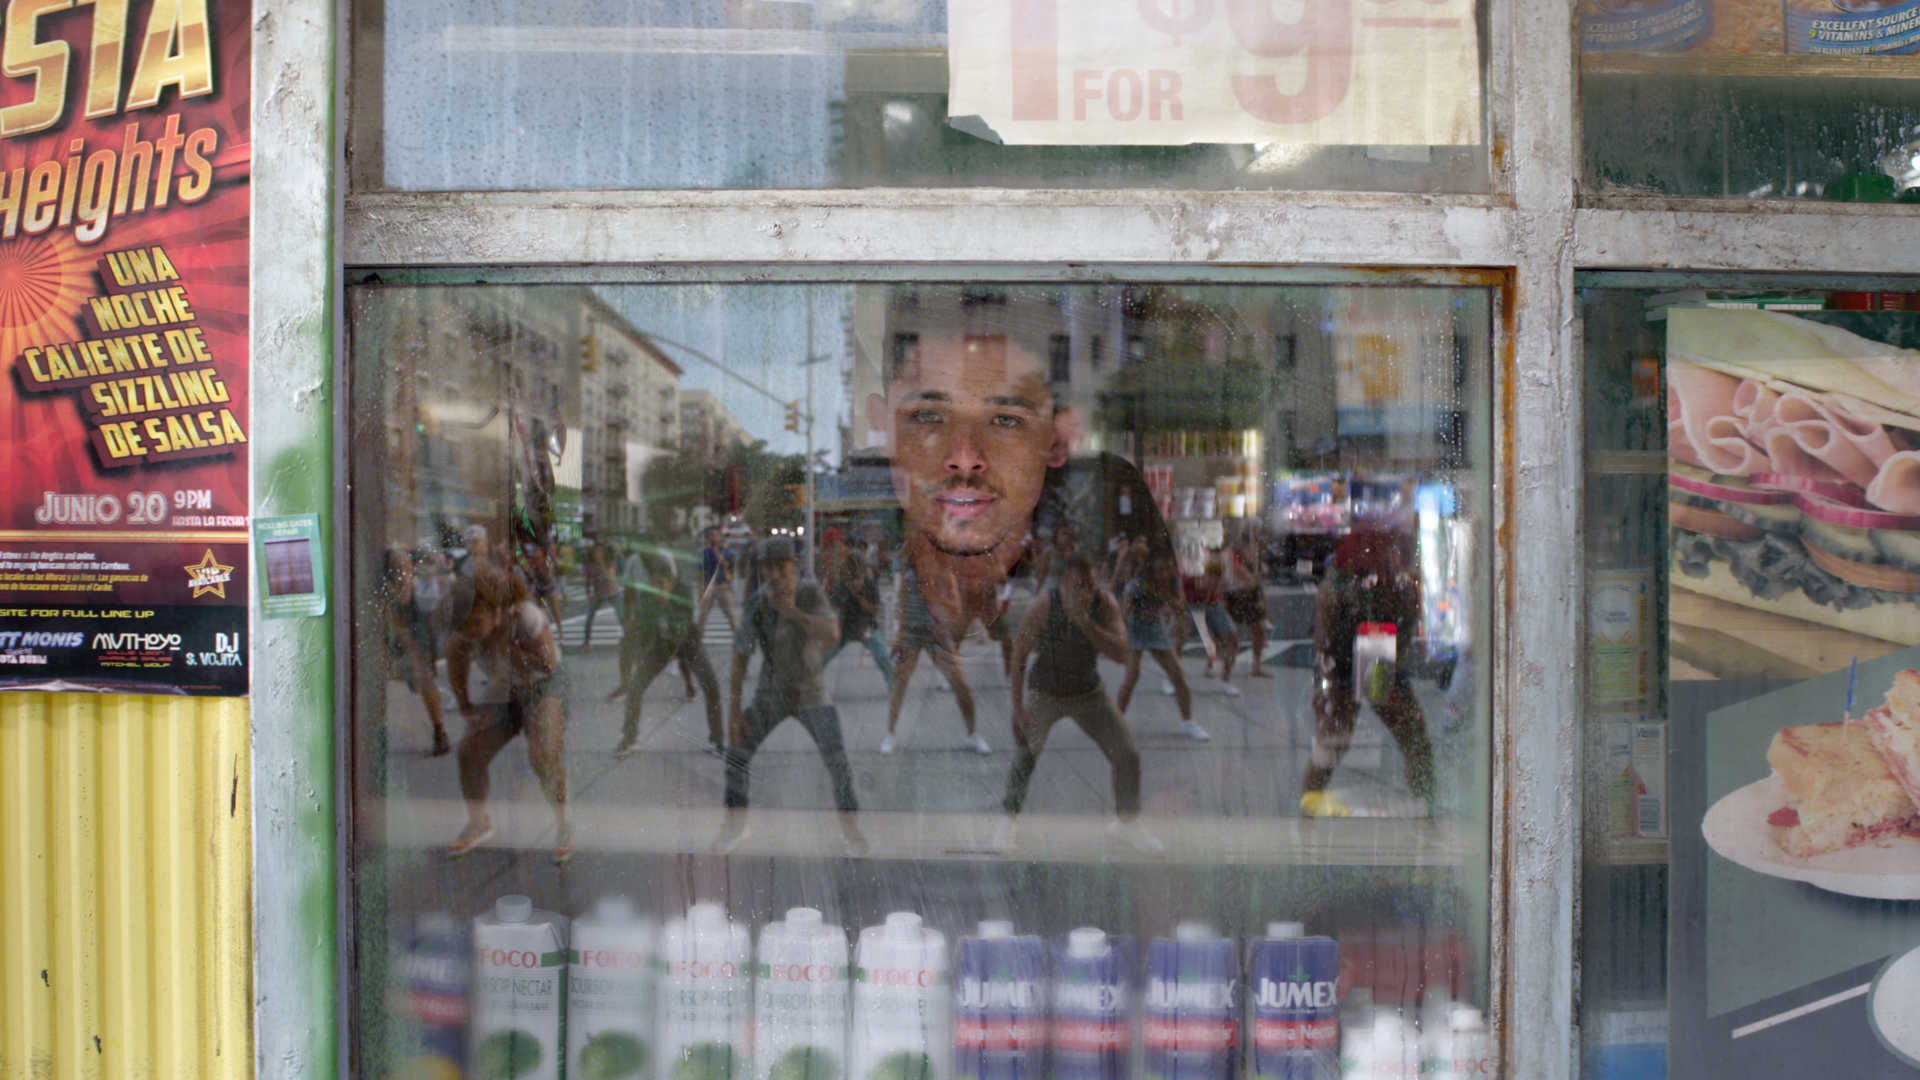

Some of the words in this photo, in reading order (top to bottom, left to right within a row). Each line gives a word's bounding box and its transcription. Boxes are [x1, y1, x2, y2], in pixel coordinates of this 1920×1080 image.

[1812, 19, 1875, 31] EXCELLENT
[1876, 6, 1919, 28] SOURCE
[1809, 29, 1817, 38] 9
[1818, 30, 1875, 41] VITAMINS
[1876, 28, 1884, 38] &
[1073, 69, 1184, 121] FOR
[0, 113, 217, 245] Heights
[104, 246, 182, 287] UNA
[87, 285, 195, 332] NOCHE
[23, 332, 169, 382] CALIENTE
[163, 326, 212, 365] DE
[90, 368, 231, 417] SIZZLING
[99, 421, 148, 459] DE
[143, 408, 248, 453] SALSA
[34, 491, 122, 524] JUNIO
[127, 491, 168, 524] 20
[174, 490, 212, 509] 9PM
[172, 515, 202, 527] HASTA
[203, 515, 215, 527] LA
[257, 521, 289, 530] ROLLING
[289, 519, 313, 528] GATES
[272, 528, 299, 536] REPAIR
[188, 572, 231, 588] AVAILABLE
[30, 609, 60, 617] FOR
[62, 610, 99, 618] FULL
[101, 610, 132, 618] LINE
[134, 610, 155, 618] UP
[21, 631, 85, 648] MONIS
[215, 632, 240, 653] DJ
[185, 652, 198, 666] S.
[199, 652, 243, 666] VOJITA
[480, 949, 538, 969] FOCO
[583, 950, 642, 969] FOCO
[674, 960, 736, 980] FOCO
[773, 964, 835, 982] FOCO
[873, 968, 933, 988] FOCO
[511, 979, 553, 996] NECTAR
[1254, 975, 1340, 1008] JUMEX
[1255, 1023, 1296, 1040] Guava
